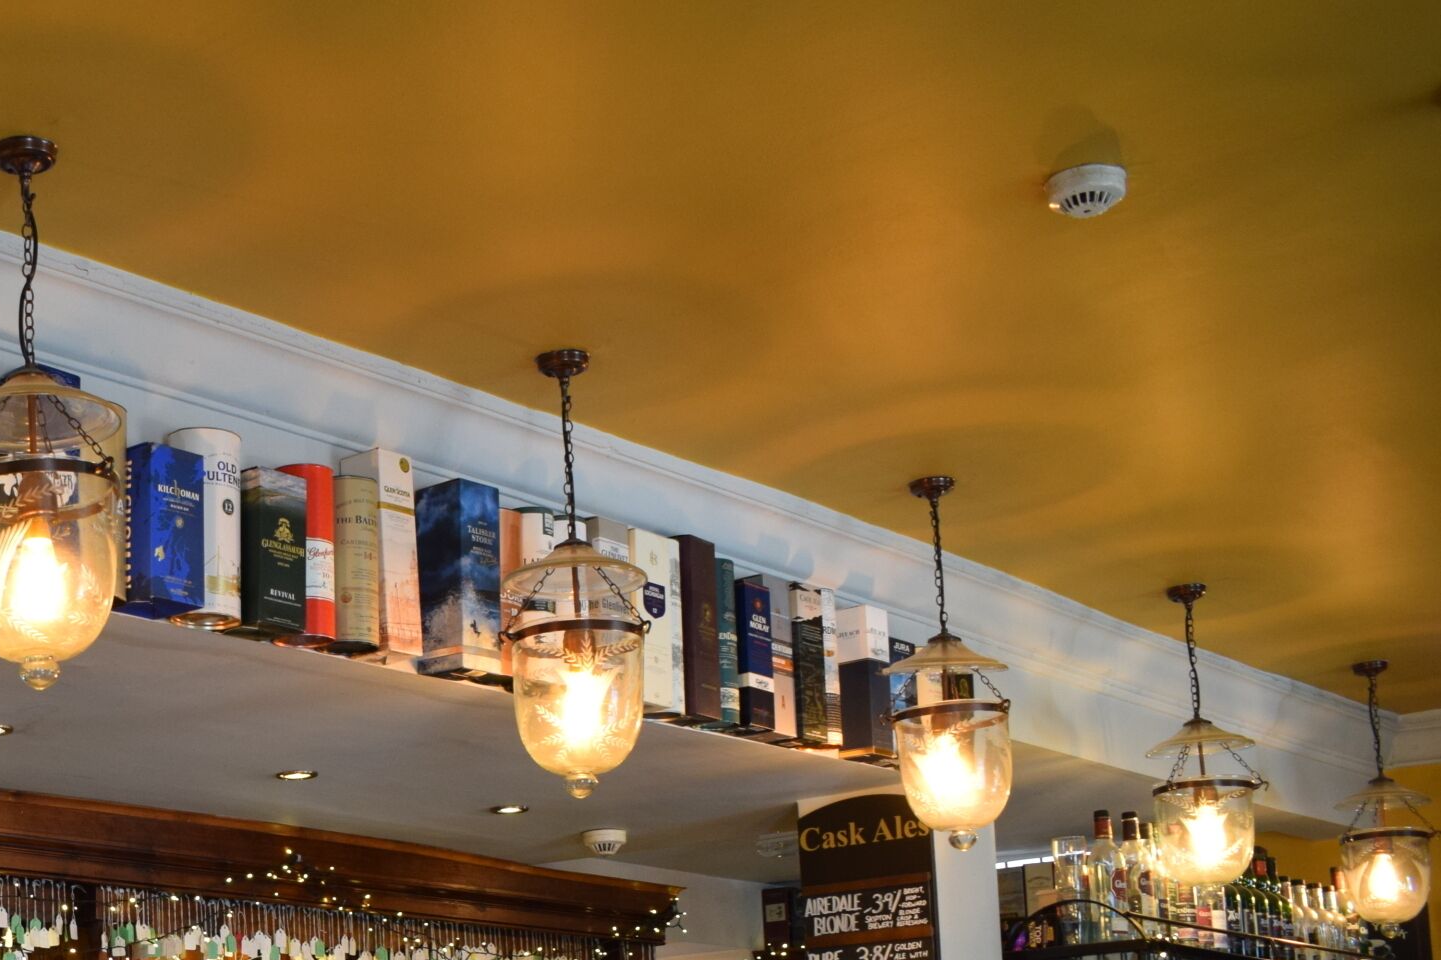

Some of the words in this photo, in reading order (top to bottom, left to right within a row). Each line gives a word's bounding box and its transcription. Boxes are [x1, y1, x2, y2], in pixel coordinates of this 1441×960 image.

[217, 460, 237, 474] OLD
[223, 502, 233, 512] 12
[467, 525, 496, 539] TALISKER
[471, 535, 493, 546] STORM
[269, 588, 296, 600] REVIVAL
[752, 613, 767, 624] GLEN
[749, 620, 770, 633] MORAY
[799, 821, 868, 851] Cask
[873, 815, 930, 842] Ales
[804, 893, 862, 917] AIREDALE
[814, 912, 860, 936] BLONDE
[894, 941, 922, 952] GOLDEN
[894, 953, 907, 960] ALE
[909, 950, 929, 959] WITH
